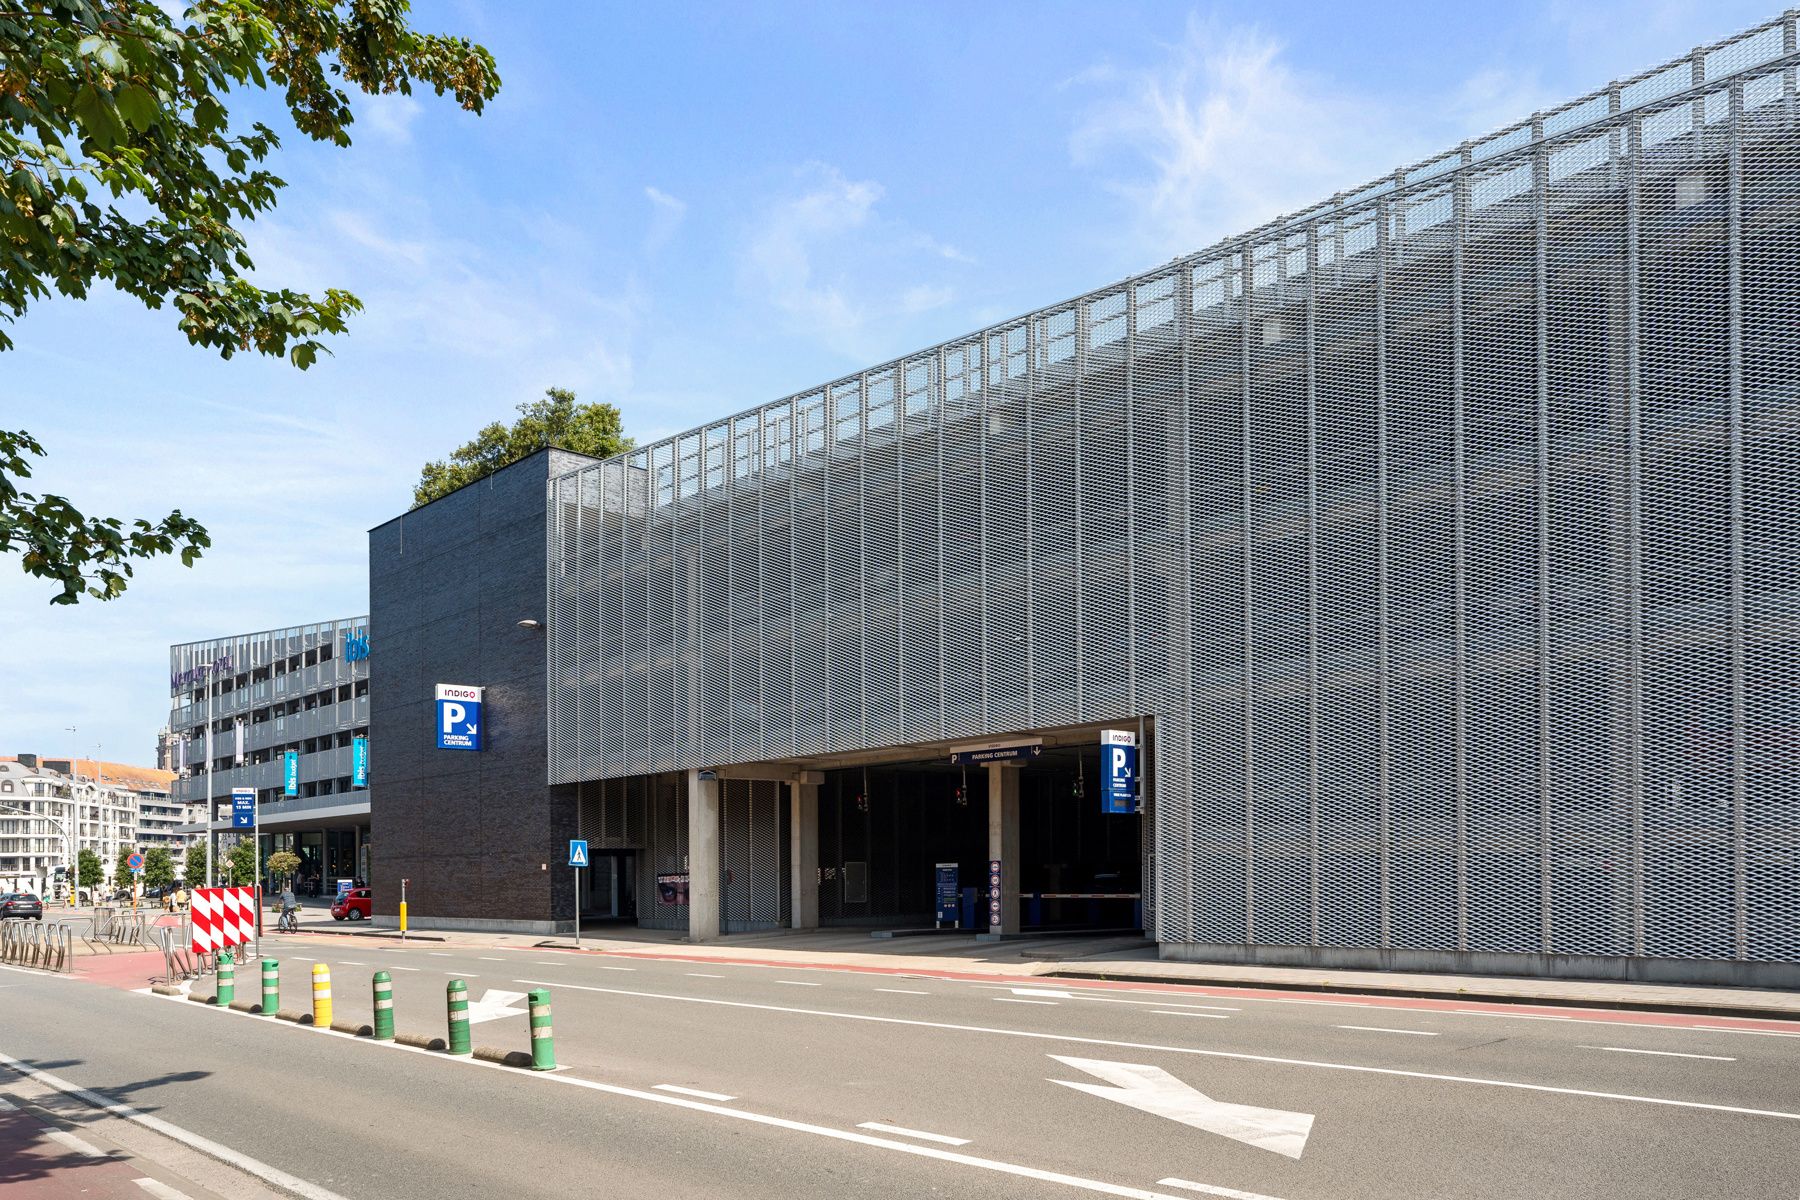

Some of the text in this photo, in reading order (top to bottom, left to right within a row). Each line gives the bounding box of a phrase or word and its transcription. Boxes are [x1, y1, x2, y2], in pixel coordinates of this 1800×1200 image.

[444, 689, 475, 698] INDIGO
[443, 702, 466, 733] P
[951, 750, 1018, 764] P PARKING CENTRUM
[1112, 747, 1126, 777] P
